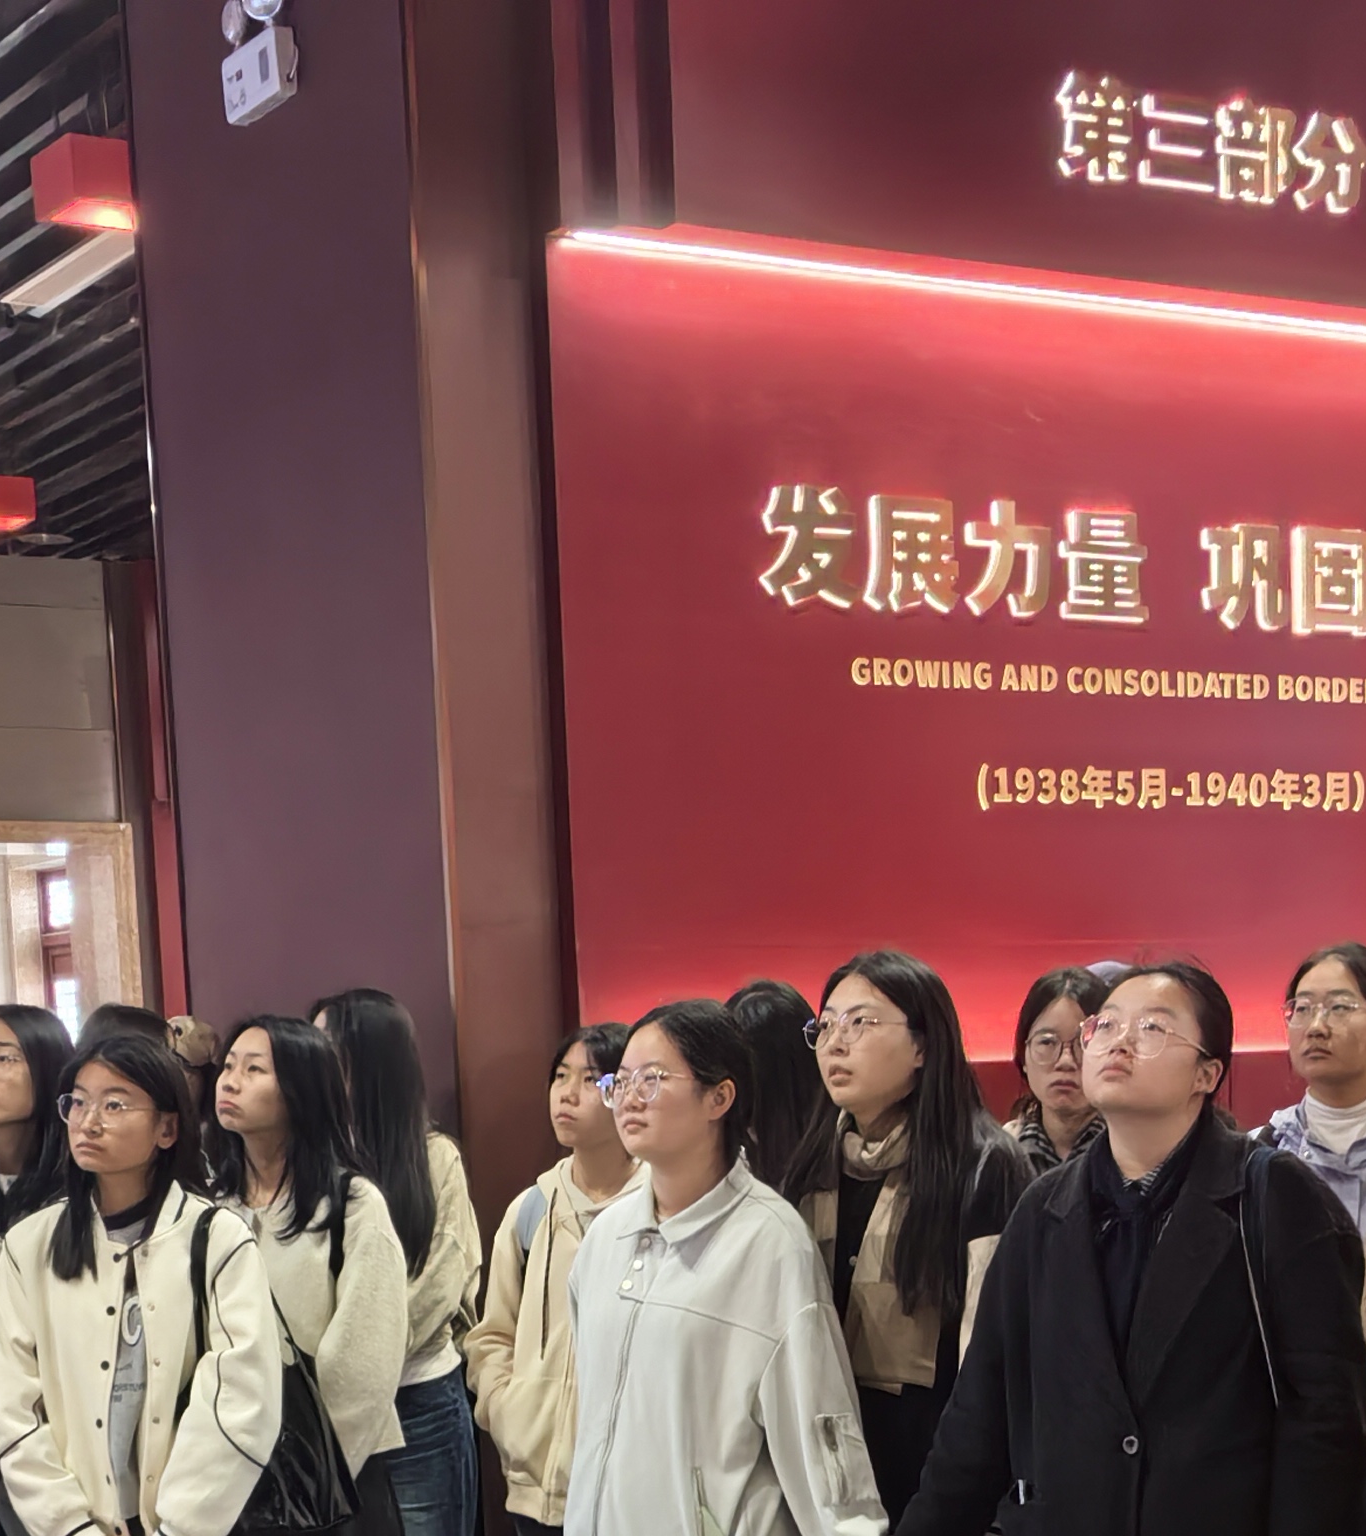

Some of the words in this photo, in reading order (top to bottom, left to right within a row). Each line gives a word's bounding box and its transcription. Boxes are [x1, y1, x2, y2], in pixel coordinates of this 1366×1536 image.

[759, 484, 1150, 625] 发展力量
[851, 656, 992, 691] GROWING
[1001, 663, 1058, 694] AND
[1067, 666, 1270, 701] CONSOLIDATED
[976, 764, 1366, 813] (1938年5月-1940年3月)
